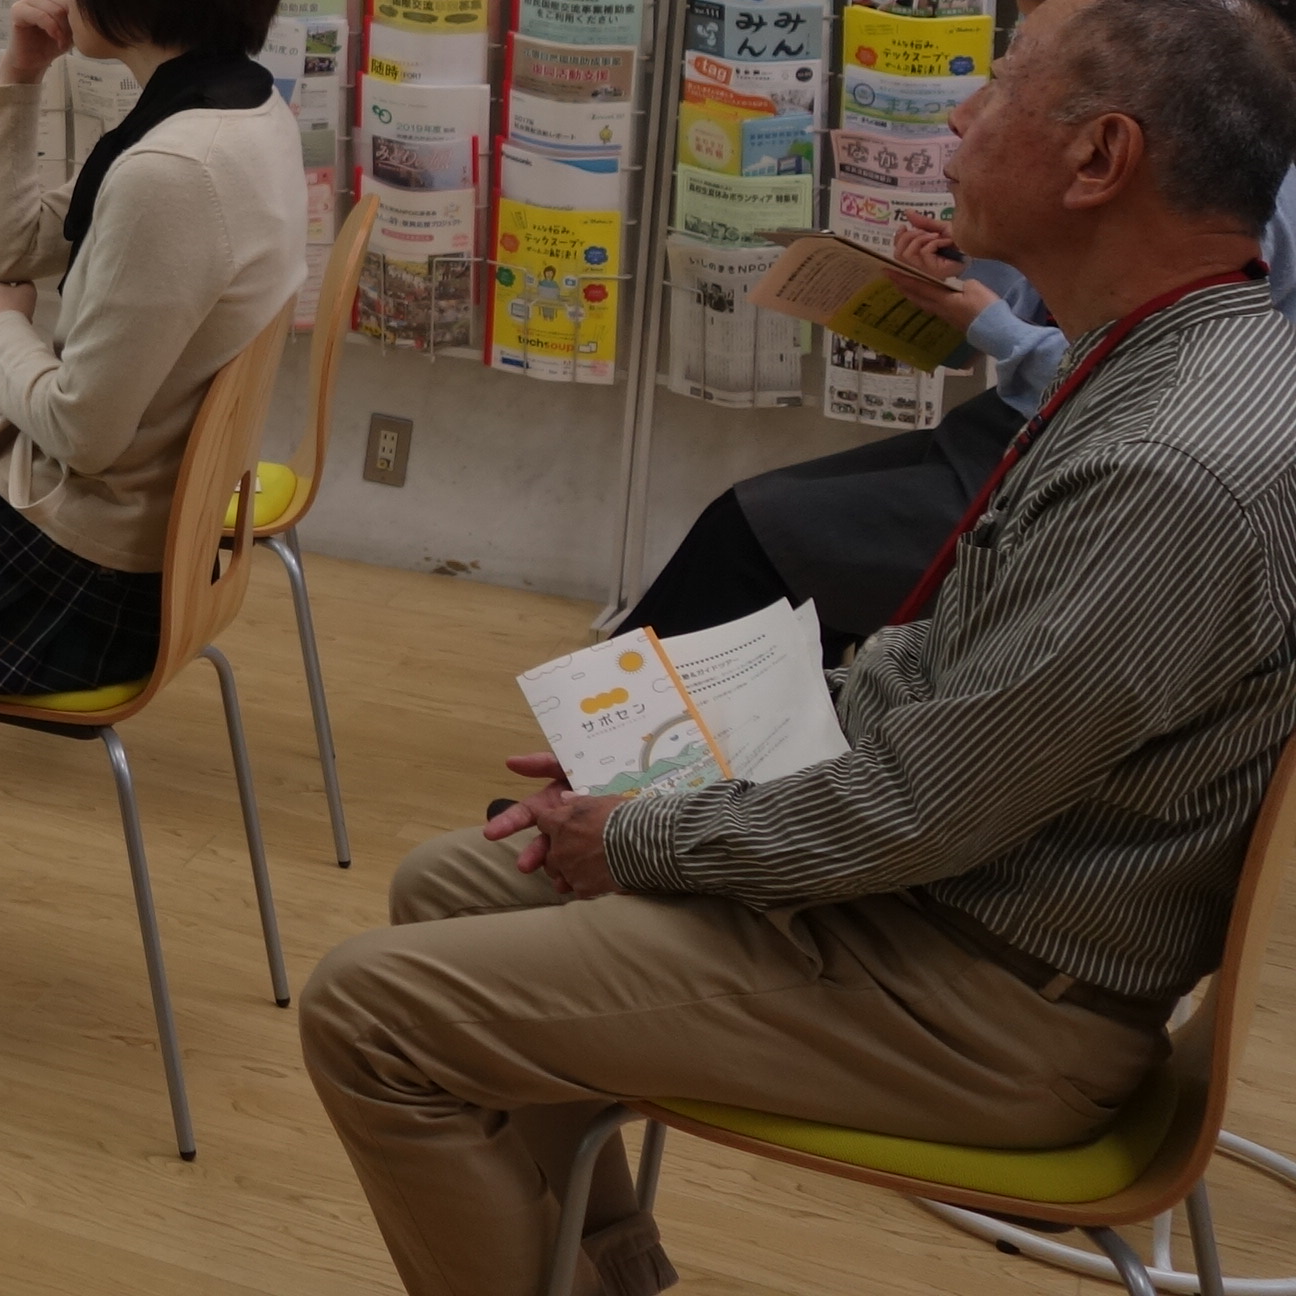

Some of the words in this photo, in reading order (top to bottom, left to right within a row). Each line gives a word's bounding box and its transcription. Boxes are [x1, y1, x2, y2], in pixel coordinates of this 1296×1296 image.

[370, 58, 400, 80] 随時
[517, 334, 575, 354] techsoup
[580, 702, 647, 734] サポセン
